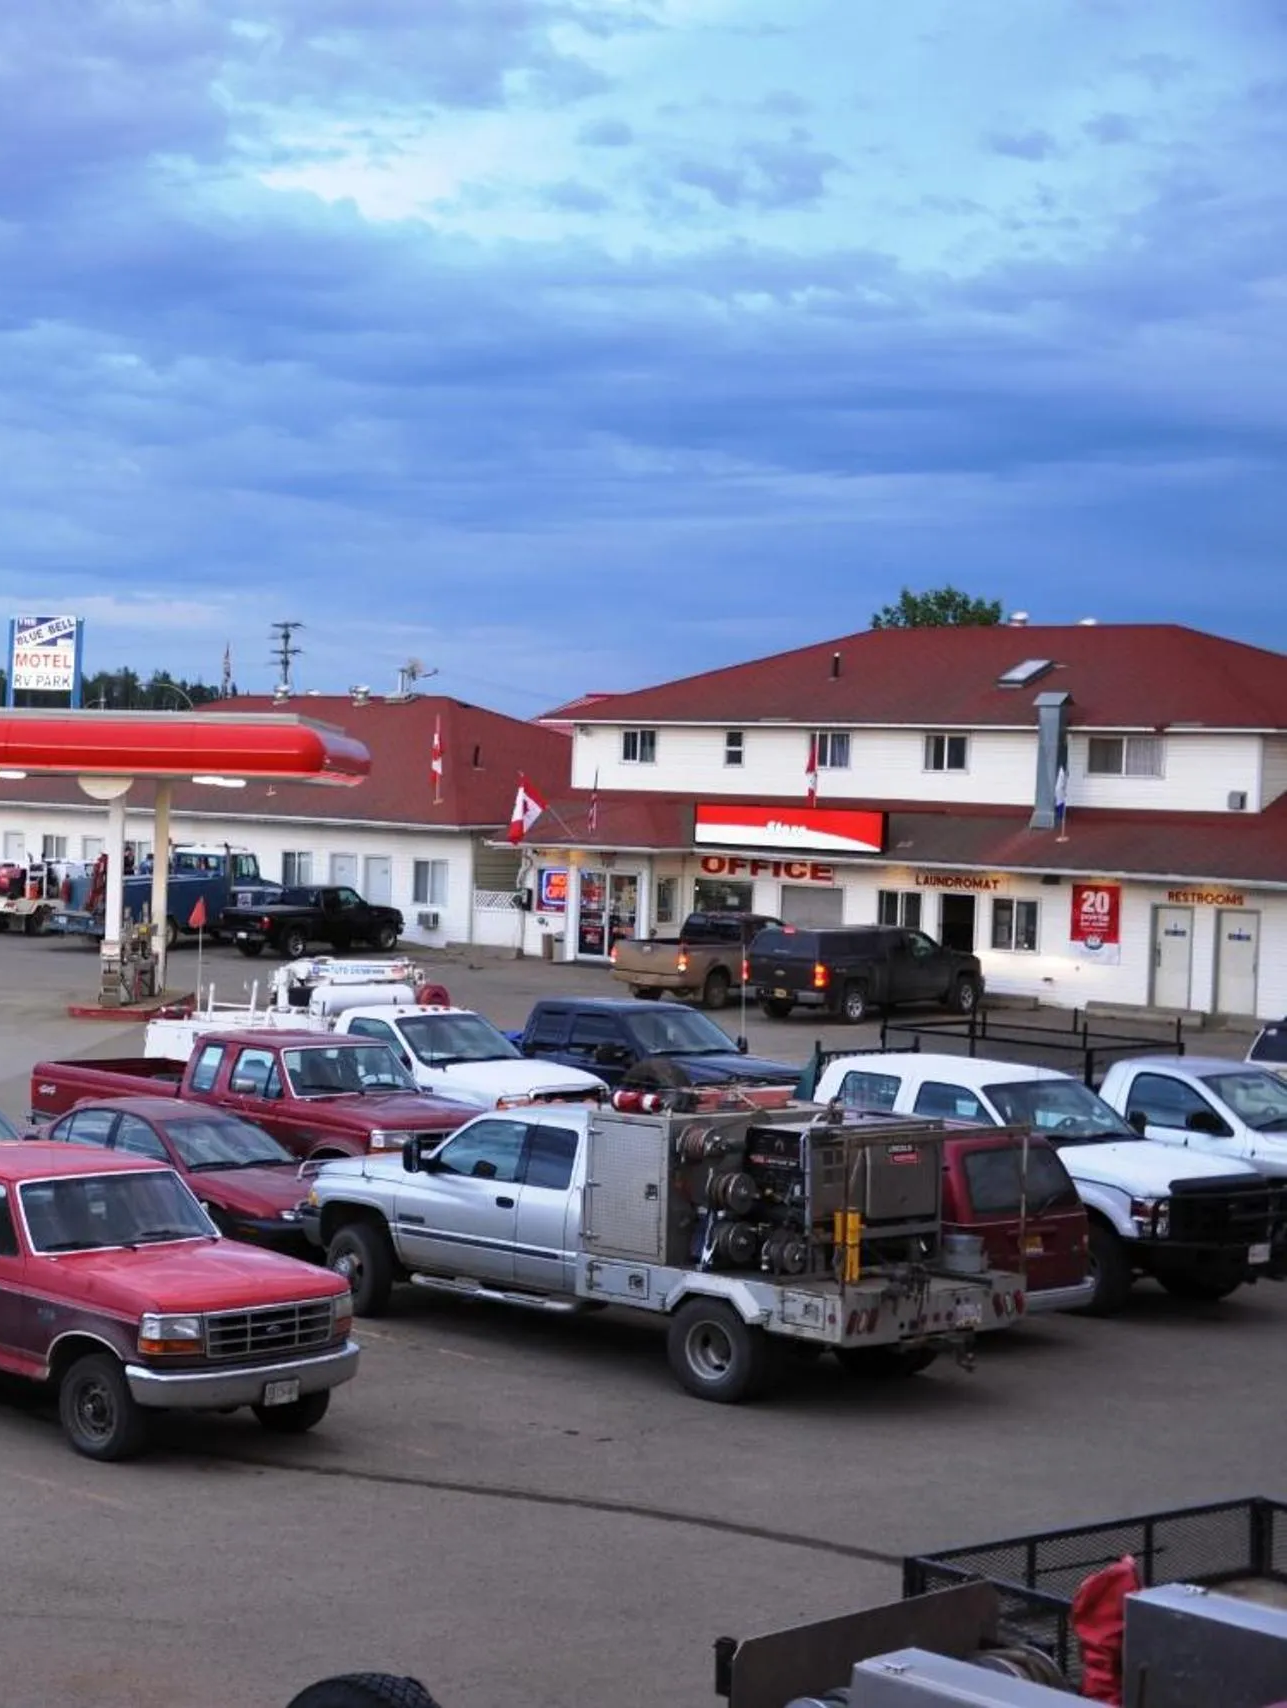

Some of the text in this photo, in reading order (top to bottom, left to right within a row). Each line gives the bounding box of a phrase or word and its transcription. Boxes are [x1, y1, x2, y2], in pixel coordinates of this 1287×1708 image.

[16, 618, 75, 645] BLUE BELL
[15, 652, 72, 669] MOTEL
[14, 674, 70, 687] RV PARK
[700, 856, 834, 881] OFFICE
[915, 873, 1000, 889] LAUNDROMAT
[1081, 890, 1110, 913] 20
[1167, 890, 1244, 906] RESTROOMS
